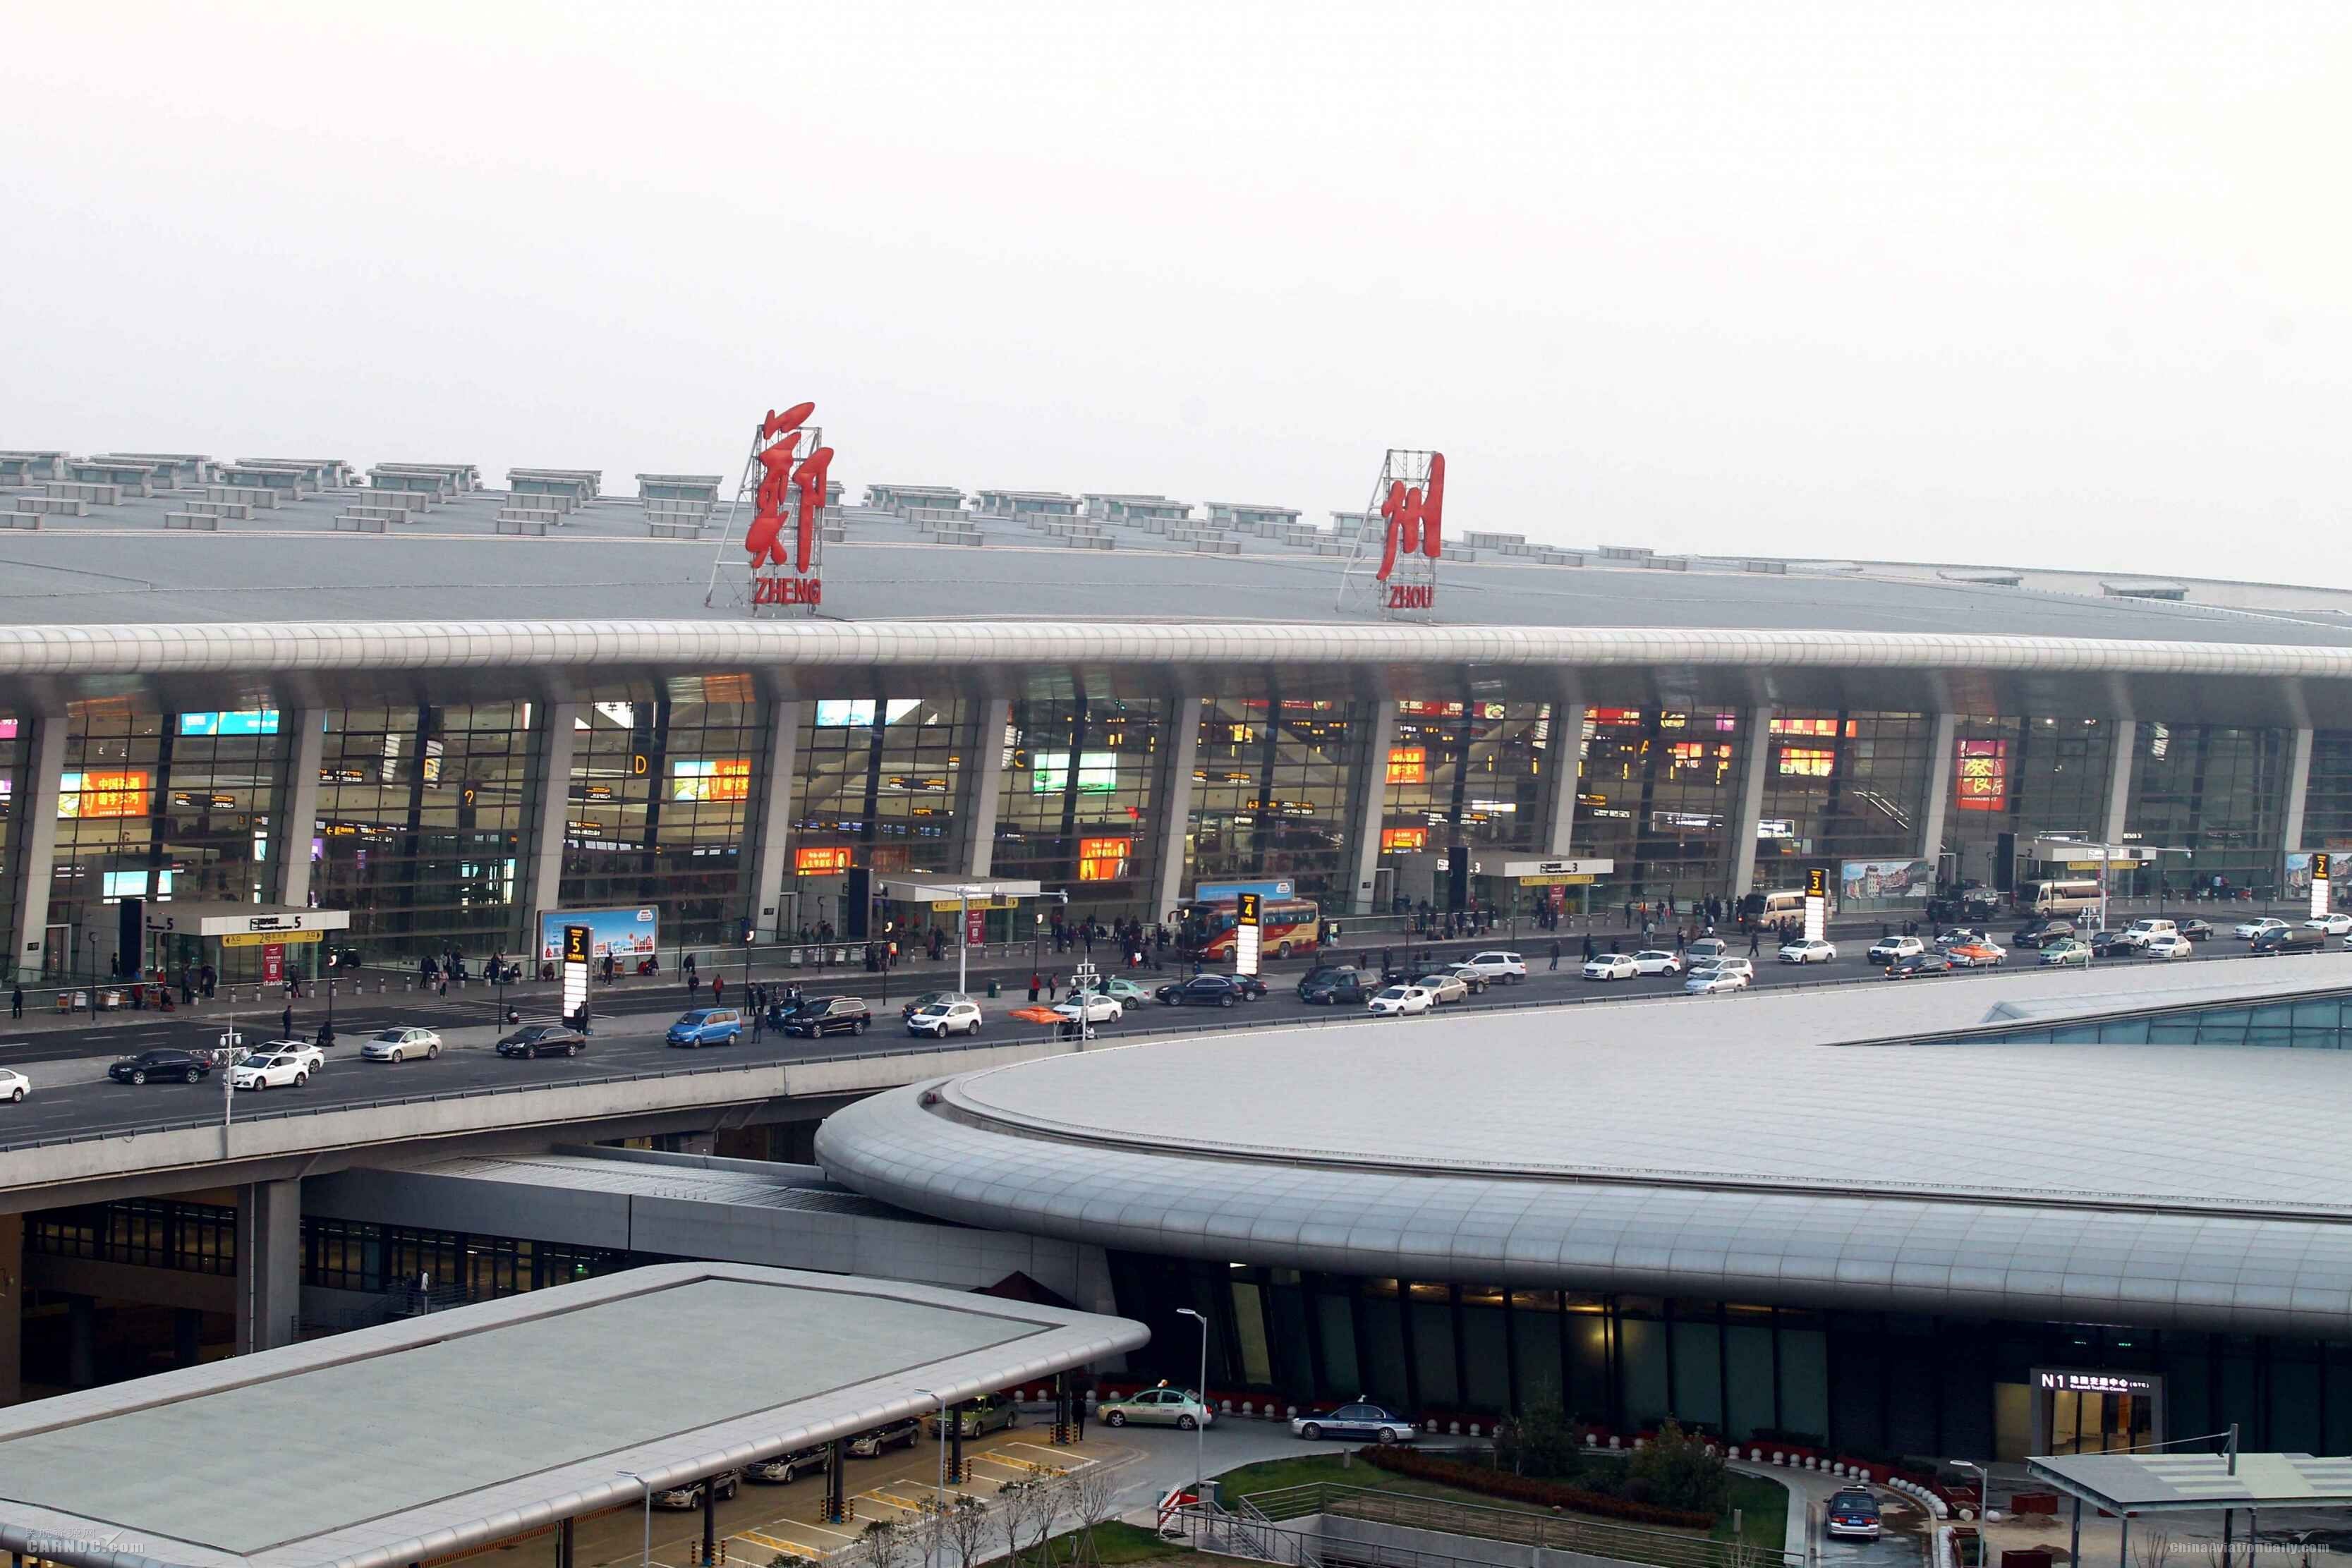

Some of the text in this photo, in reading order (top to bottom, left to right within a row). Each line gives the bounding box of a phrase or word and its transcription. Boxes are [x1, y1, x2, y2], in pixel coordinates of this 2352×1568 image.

[1376, 452, 1445, 581] 州
[755, 578, 821, 604] ZHENG
[1389, 585, 1433, 609] ZHOU
[636, 755, 646, 774] D
[1572, 863, 1578, 873] 3
[2317, 862, 2324, 873] 2
[1812, 877, 1819, 889] 3
[1244, 904, 1253, 917] 4
[166, 918, 174, 930] 5
[294, 916, 302, 928] 5
[572, 937, 581, 953] 5
